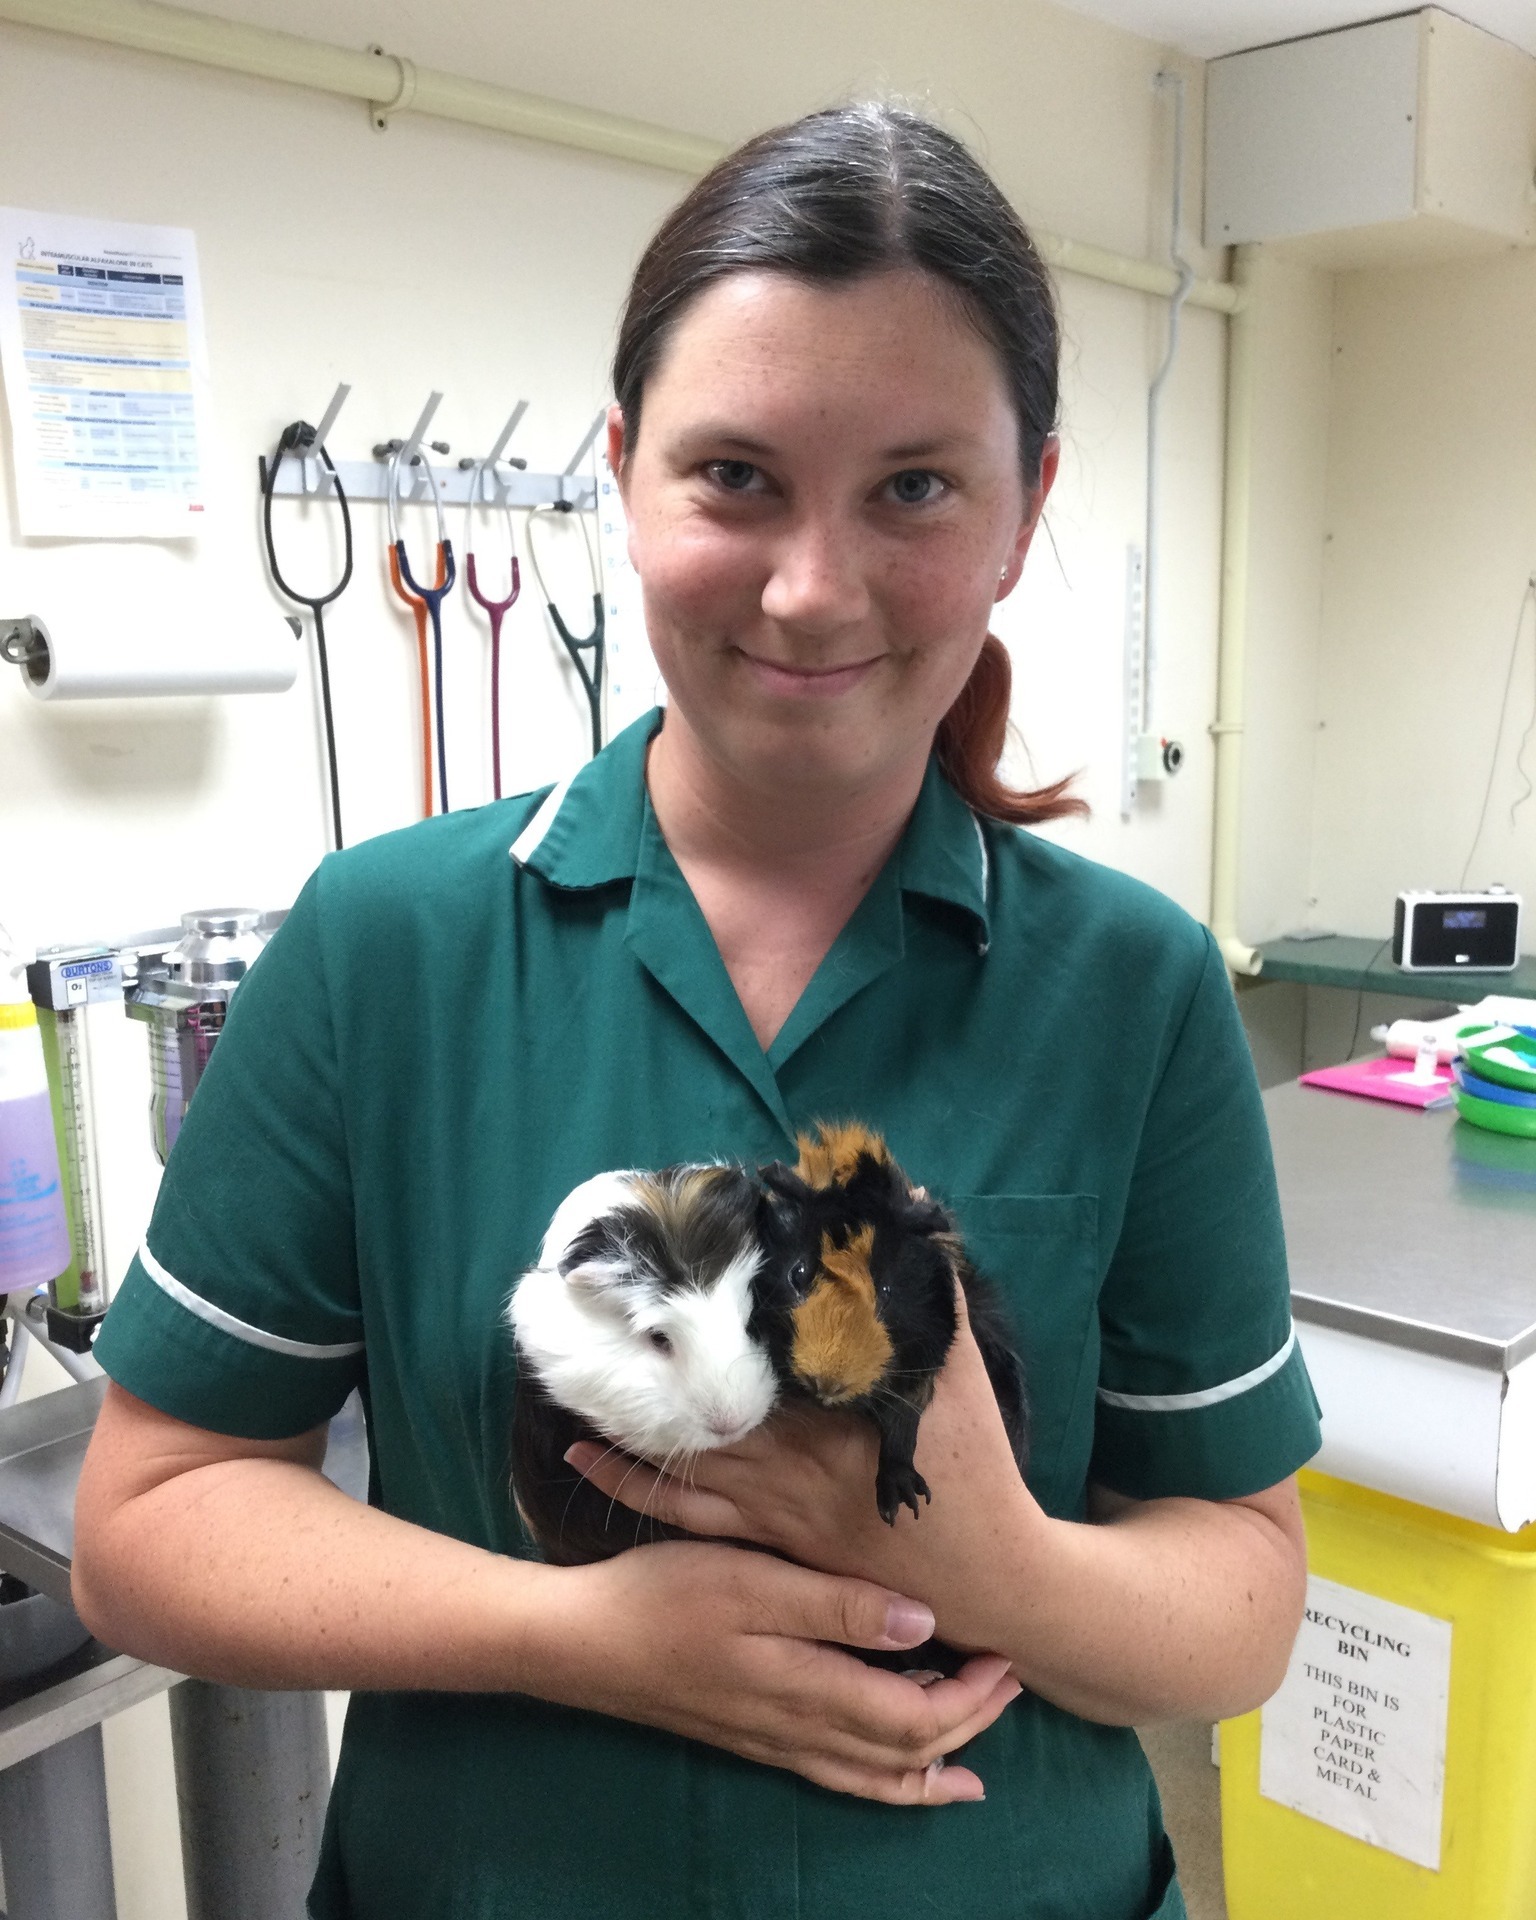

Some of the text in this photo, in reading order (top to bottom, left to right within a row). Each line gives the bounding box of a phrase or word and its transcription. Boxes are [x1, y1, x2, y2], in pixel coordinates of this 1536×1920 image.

[64, 960, 111, 978] BURTONS
[1337, 1639, 1369, 1662] BIN
[1303, 1662, 1400, 1711] THIS BIN IS
[1332, 1694, 1366, 1719] FOR
[1313, 1706, 1386, 1746] PLASTIC
[1320, 1729, 1375, 1762] PAPER
[1313, 1745, 1381, 1784] CARD &
[1315, 1765, 1377, 1802] METAL
